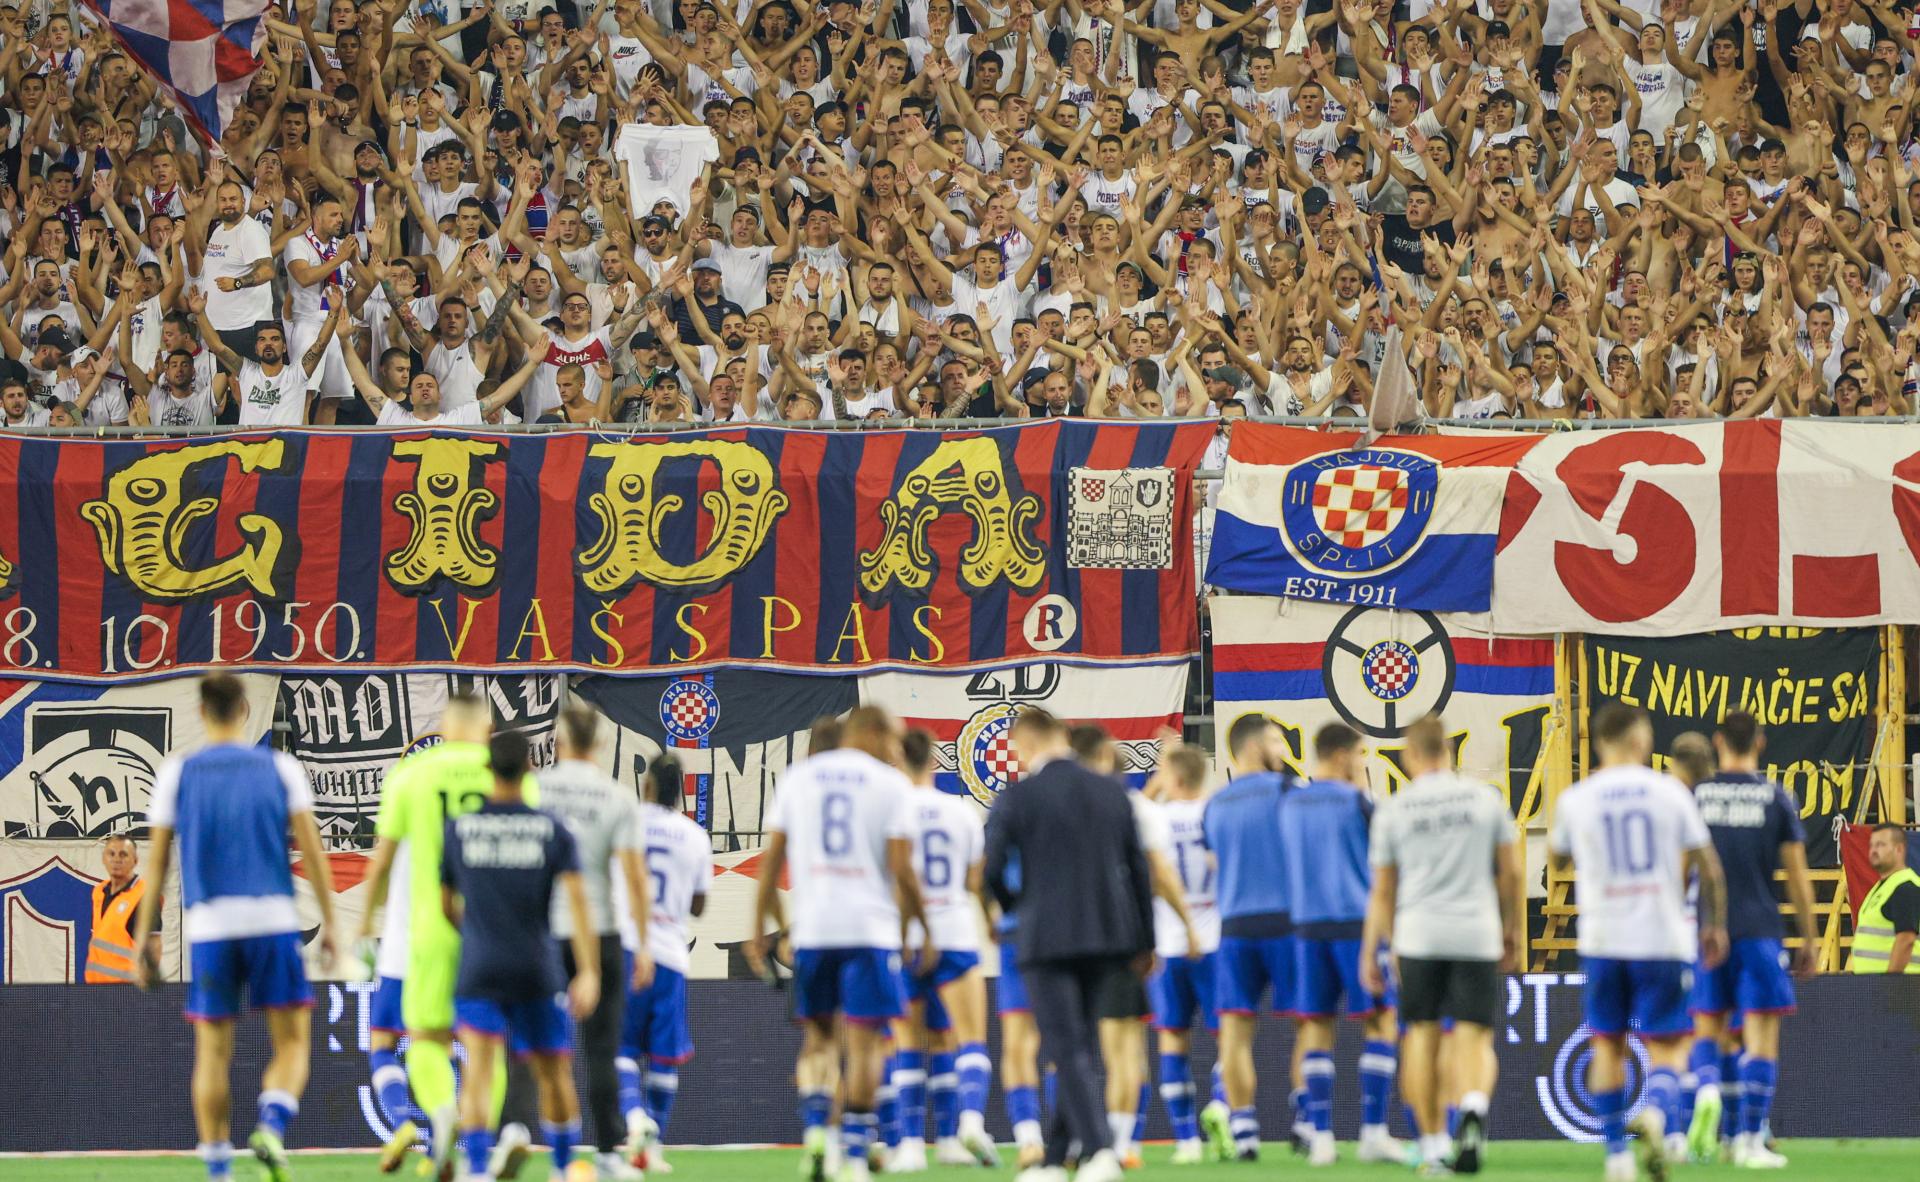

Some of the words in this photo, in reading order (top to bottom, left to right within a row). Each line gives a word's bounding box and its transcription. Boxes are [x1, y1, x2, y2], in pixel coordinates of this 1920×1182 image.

[618, 46, 638, 54] NIKE
[1299, 532, 1395, 569] SPLIT
[1283, 577, 1341, 602] EST.
[1346, 583, 1398, 607] 1911
[209, 599, 366, 665] 1950.
[1367, 642, 1415, 661] HAJDUK
[666, 683, 714, 702] HAJDUK
[1370, 685, 1407, 699] SPLIT
[1596, 646, 1642, 708] UZ
[1828, 670, 1868, 723] SA
[666, 720, 710, 737] SPLIT
[822, 793, 852, 858] 8
[1603, 808, 1655, 876] 10
[923, 830, 951, 887] 6
